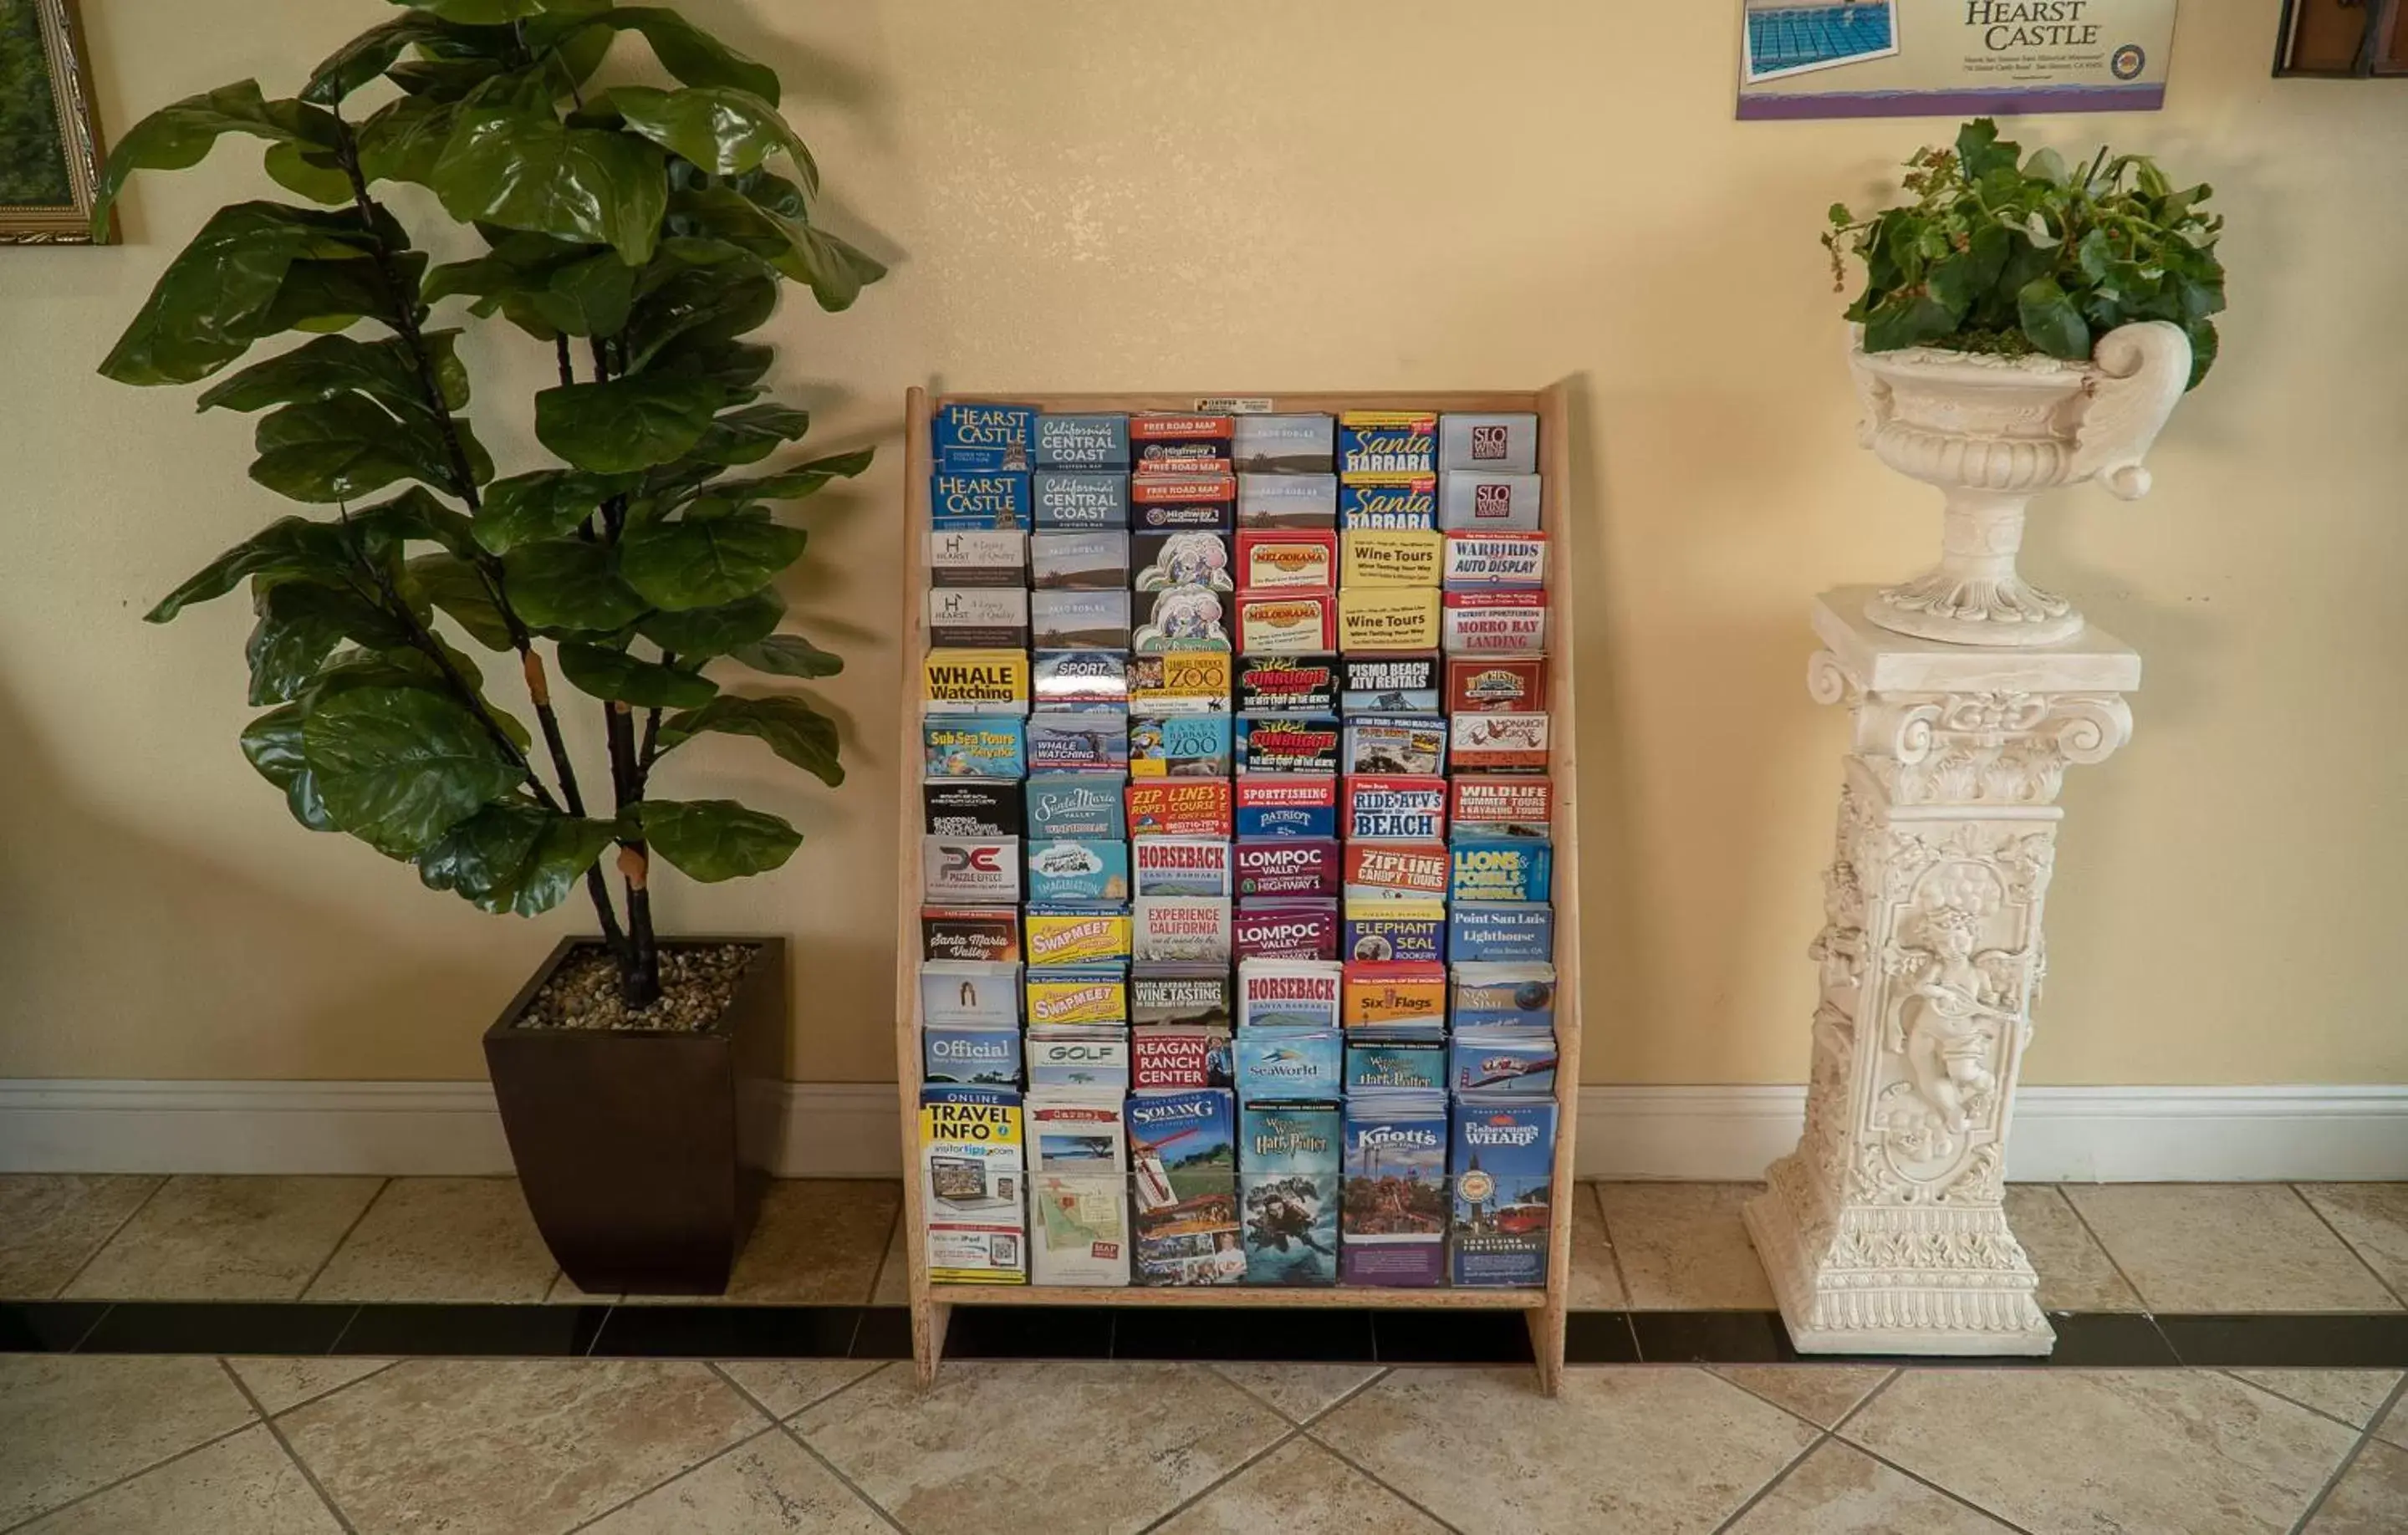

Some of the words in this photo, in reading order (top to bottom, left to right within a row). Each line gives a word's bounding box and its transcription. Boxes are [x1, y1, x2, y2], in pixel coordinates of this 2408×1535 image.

[1965, 0, 2085, 25] HEARST
[1984, 25, 2099, 51] CASTLE
[951, 407, 1028, 426] HEARST
[957, 425, 1027, 444] CASTLE
[1043, 421, 1112, 437] California's
[1474, 427, 1506, 441] SLO
[1042, 437, 1116, 449] CENTRAL
[1346, 430, 1434, 459] Santa
[1475, 441, 1505, 452] WINE
[1052, 450, 1105, 462] COAST
[1347, 454, 1431, 472] BARBARA
[1149, 463, 1169, 472] FREE
[1171, 462, 1198, 471] ROAD
[1199, 462, 1221, 471] MAP
[939, 477, 1018, 495] HEARST
[1046, 479, 1114, 495] California's
[1043, 495, 1117, 506] CENTRAL
[1477, 487, 1509, 500] SLO
[946, 494, 1016, 513] CASTLE
[1346, 488, 1434, 518] Santa
[1477, 500, 1508, 511] WINE
[1054, 507, 1106, 519] COAST
[1166, 510, 1210, 518] Highway
[1347, 513, 1431, 529] BARBARA
[1255, 553, 1324, 561] MELODRAMA
[1354, 547, 1391, 561] Wine
[1395, 550, 1433, 561] Tours
[1455, 543, 1539, 557] WARBIRDS
[1455, 560, 1486, 573] AUTO
[1487, 560, 1536, 573] DISPLAY
[1248, 609, 1316, 620] MELODRAMA
[1345, 616, 1383, 627] Wine
[1386, 614, 1425, 626] Tours
[1457, 620, 1507, 633] MORRO
[1511, 620, 1539, 632] BAY
[1467, 635, 1527, 648] LANDING
[929, 667, 1013, 685] WHALE
[1059, 662, 1107, 676] SPORT
[1348, 663, 1389, 678] PISMO
[1390, 662, 1430, 676] BEACH
[1170, 668, 1225, 687] ZOO
[1245, 669, 1327, 685] SUNBUGGIE
[1349, 676, 1375, 689] ATV
[1375, 676, 1426, 689] RENTALS
[1467, 671, 1525, 691] WINCHESTER
[931, 686, 1013, 702] Watching
[1496, 719, 1544, 729] MONARCH
[1503, 727, 1535, 737] GROVE
[1038, 742, 1077, 751] WHALE
[1171, 736, 1217, 756] ZOO
[1251, 732, 1334, 747] SUNBUGGIE
[1133, 790, 1163, 805] ZIP
[1167, 787, 1215, 802] LINES
[1243, 788, 1328, 799] SPORTFISHING
[1461, 786, 1547, 798] WILDLIFE
[1035, 794, 1076, 822] Santa
[1073, 788, 1116, 808] Maria
[1131, 803, 1166, 815] ROPES
[1171, 800, 1215, 812] COURSE
[1355, 794, 1395, 808] RIDE
[1512, 798, 1545, 806] TOURS
[1261, 811, 1311, 827] PATRIOT
[1356, 815, 1433, 835] BEACH
[1137, 846, 1224, 869] HORSEBACK
[1240, 849, 1322, 866] LOMPOC
[1362, 854, 1444, 875] ZIPLINE
[1455, 851, 1520, 869] LIONS
[1261, 864, 1300, 874] VALLEY
[1258, 878, 1311, 891] HIGHWAY
[1314, 878, 1320, 889] 1
[1357, 869, 1401, 884] CANOPY
[1407, 873, 1443, 887] TOURS
[1149, 907, 1220, 920] EXPERIENCE
[1455, 913, 1488, 924] Point
[1492, 914, 1516, 923] San
[1518, 913, 1545, 924] Luis
[1150, 921, 1219, 934] CALIFORNIA
[1237, 922, 1320, 943] LOMPOC
[1355, 922, 1436, 935] ELEPHANT
[931, 932, 967, 949] Santa
[970, 934, 1008, 947] Maria
[1396, 937, 1436, 949] SEAL
[1462, 930, 1535, 943] Lighthouse
[1259, 938, 1298, 950] VALLEY
[950, 946, 992, 959] Valley
[1135, 989, 1169, 1001] WINE
[1171, 989, 1221, 1002] TASTING
[1248, 978, 1335, 1001] HORSEBACK
[1361, 997, 1384, 1008] Six
[1395, 997, 1432, 1009] Flags
[933, 1040, 1009, 1058] Official
[1049, 1047, 1114, 1060] GOLF
[1136, 1043, 1204, 1055] REAGAN
[1140, 1057, 1200, 1068] RANCH
[1139, 1070, 1203, 1084] CENTER
[1249, 1065, 1318, 1076] SeaWorld
[947, 1094, 999, 1104] ONLINE
[926, 1104, 1013, 1123] TRAVEL
[1132, 1100, 1212, 1124] SOLVANG
[933, 1124, 990, 1140] INFO
[1466, 1122, 1538, 1137] Fisherman's
[1358, 1126, 1437, 1148] Knott's
[1466, 1133, 1534, 1146] WHARF
